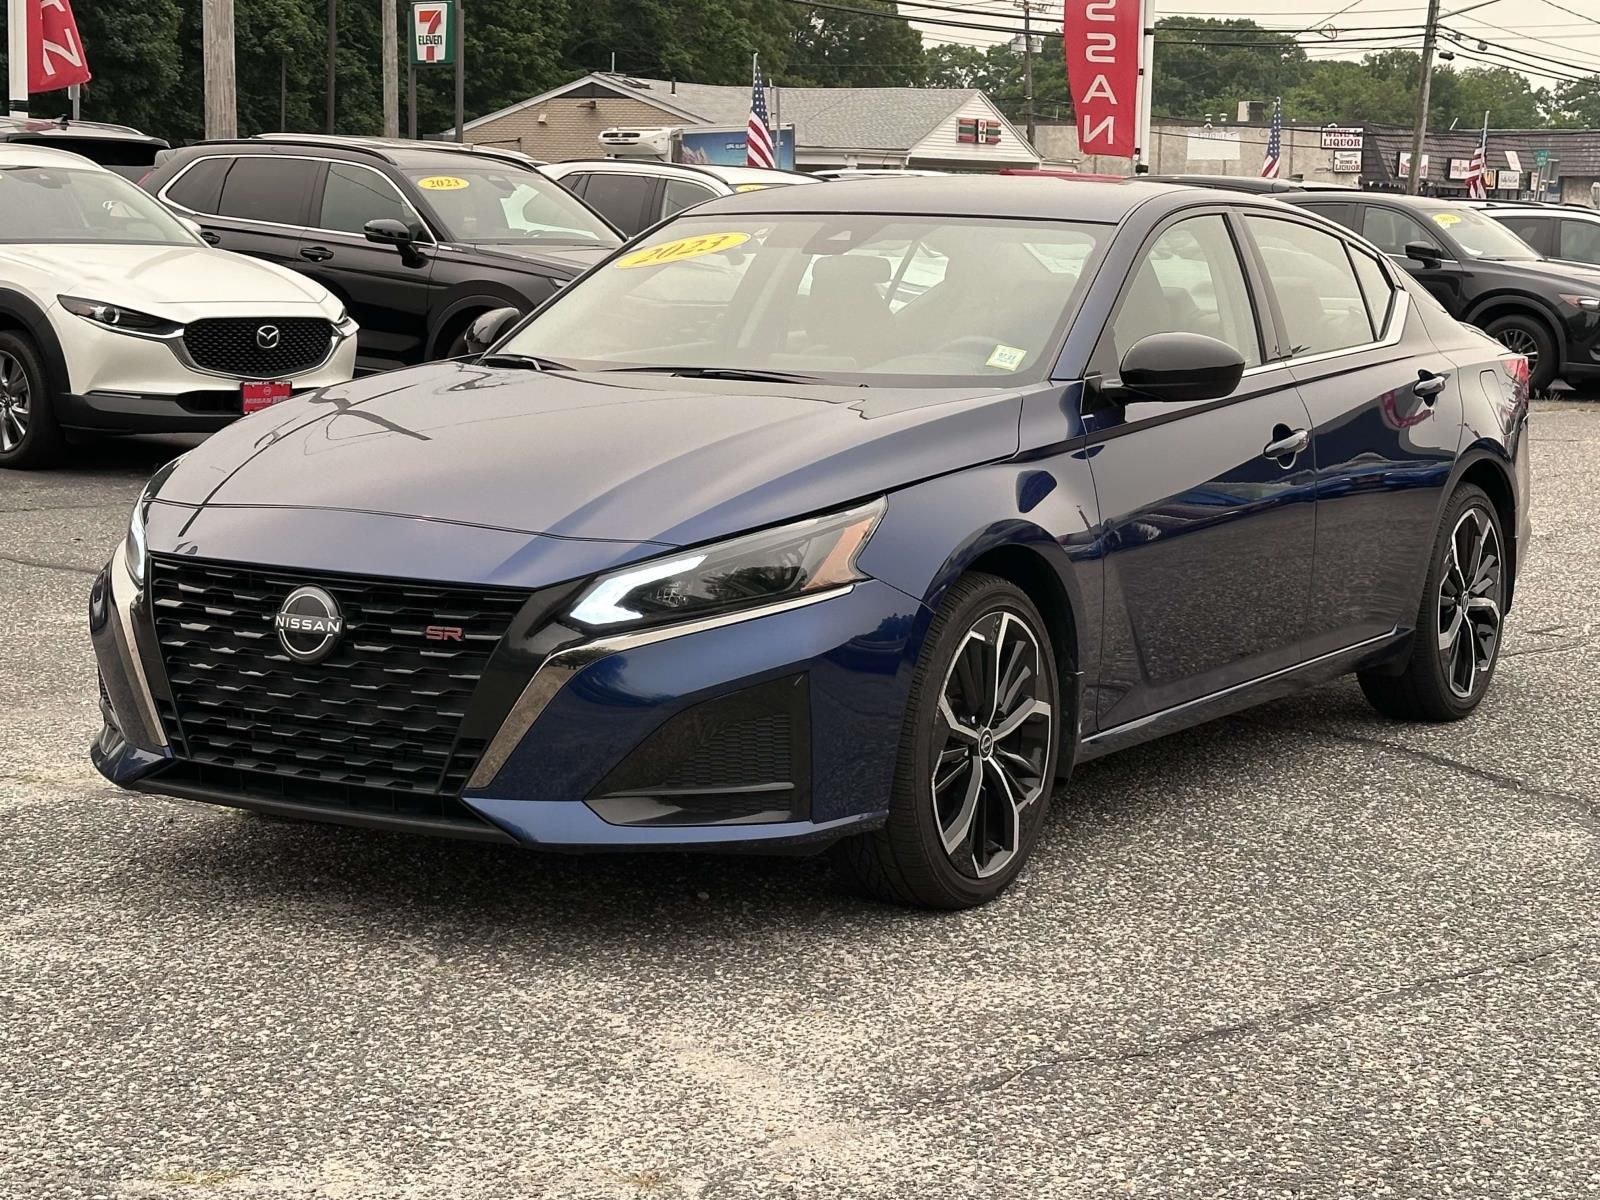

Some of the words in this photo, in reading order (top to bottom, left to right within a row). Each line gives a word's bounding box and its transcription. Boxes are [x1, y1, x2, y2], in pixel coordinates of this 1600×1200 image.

[1323, 138, 1361, 146] LIQUOR
[427, 178, 460, 188] 2023
[632, 235, 730, 265] 2023
[275, 615, 341, 633] NISSAN
[425, 625, 464, 641] SR
